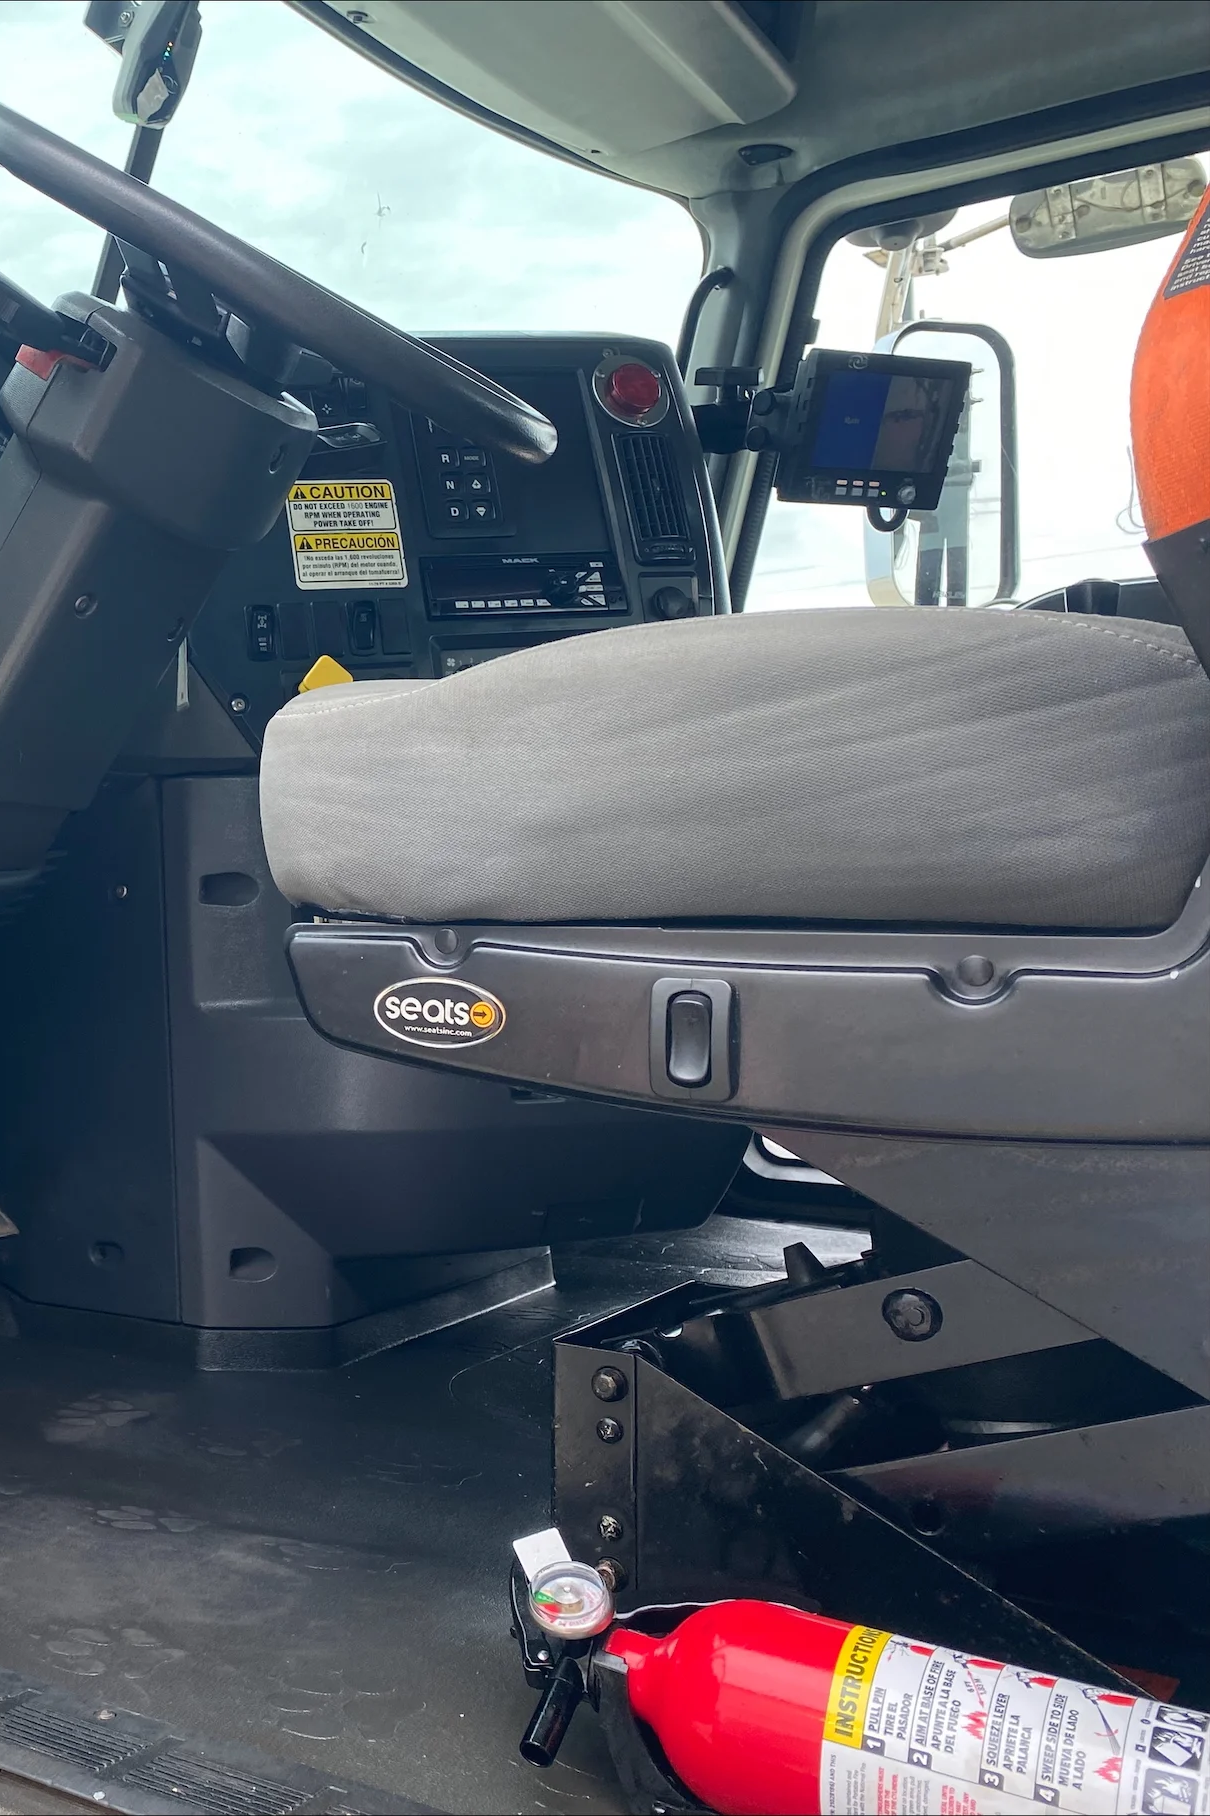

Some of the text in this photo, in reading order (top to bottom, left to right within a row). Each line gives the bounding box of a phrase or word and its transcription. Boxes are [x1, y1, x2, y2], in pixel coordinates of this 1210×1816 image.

[441, 454, 450, 463] R
[310, 486, 385, 499] CAUTION
[446, 480, 454, 489] N
[451, 507, 459, 516] D
[315, 535, 395, 549] PRECAUCIÓN
[385, 996, 470, 1026] seats
[404, 1026, 472, 1037] www.seatsinc.com
[931, 1661, 943, 1675] FIRE
[945, 1669, 956, 1687] BASE
[921, 1686, 934, 1707] BASE
[943, 1688, 950, 1699] LA
[1054, 1693, 1065, 1709] SIDE
[868, 1687, 884, 1732] PULL PIN
[897, 1693, 913, 1740] PASADOR
[919, 1709, 929, 1723] AT
[915, 1724, 926, 1746] AIM
[931, 1711, 946, 1751] APUNTE
[944, 1700, 961, 1754] DEL FUEGO
[987, 1693, 1007, 1766] SQUEEZE LEVER
[1046, 1721, 1059, 1744] SIDE
[867, 1740, 881, 1749] 1
[1003, 1714, 1020, 1771] APRIETE LA
[1017, 1727, 1032, 1774] PALANCA
[1059, 1709, 1079, 1786] MUEVA DE LADO
[913, 1753, 927, 1765] 2
[1042, 1745, 1053, 1781] SWEEP
[1075, 1751, 1086, 1780] LADO
[984, 1773, 999, 1786] 3
[1039, 1788, 1055, 1801] 4
